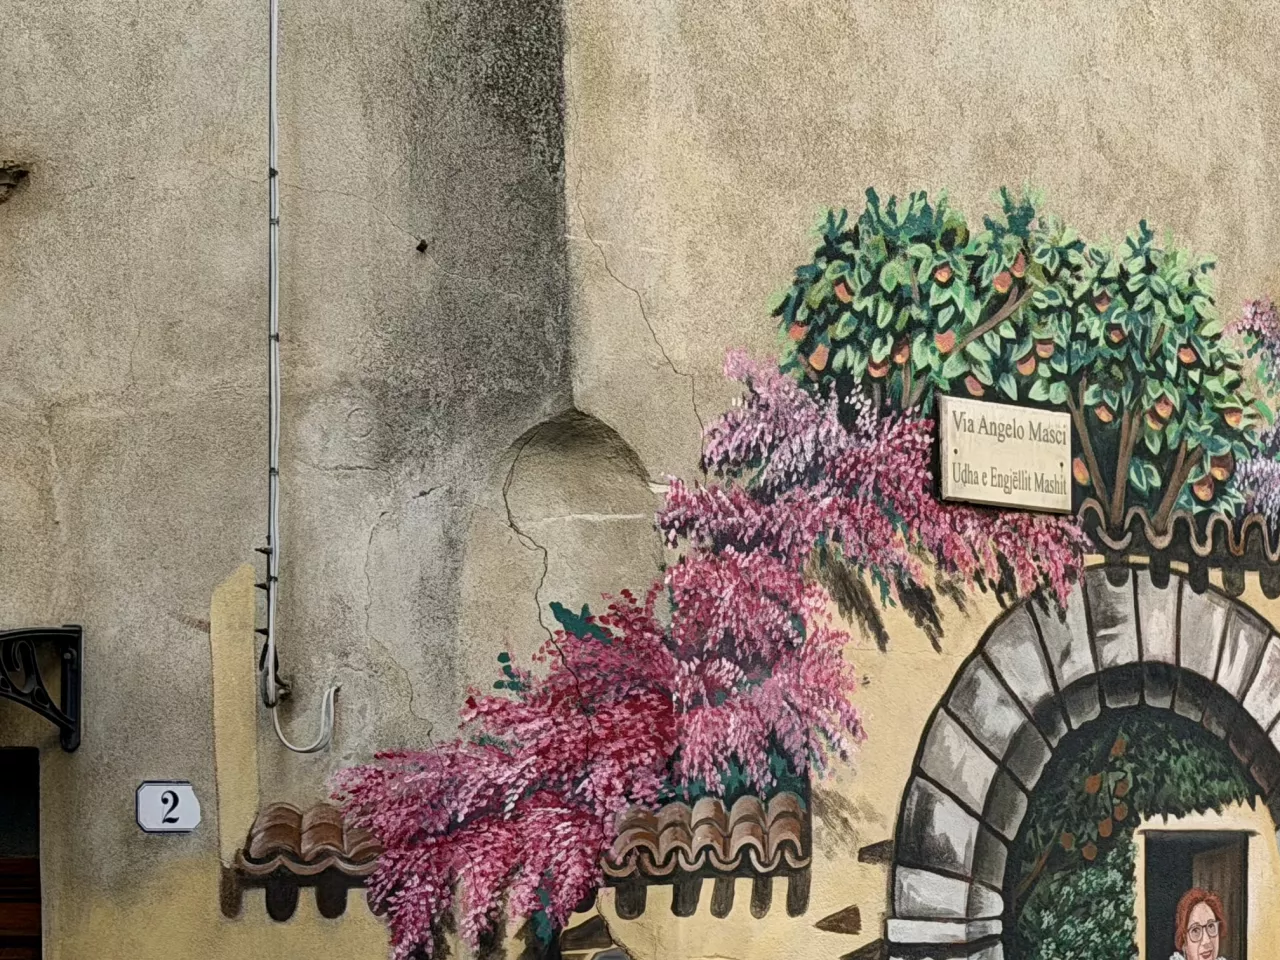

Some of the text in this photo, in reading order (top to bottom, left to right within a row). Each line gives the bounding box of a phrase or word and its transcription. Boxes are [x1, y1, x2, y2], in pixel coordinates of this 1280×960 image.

[952, 410, 1067, 446] Via Angelo Masci
[952, 462, 1067, 495] Udha e Engjëllit Mashit
[161, 790, 179, 824] 2
